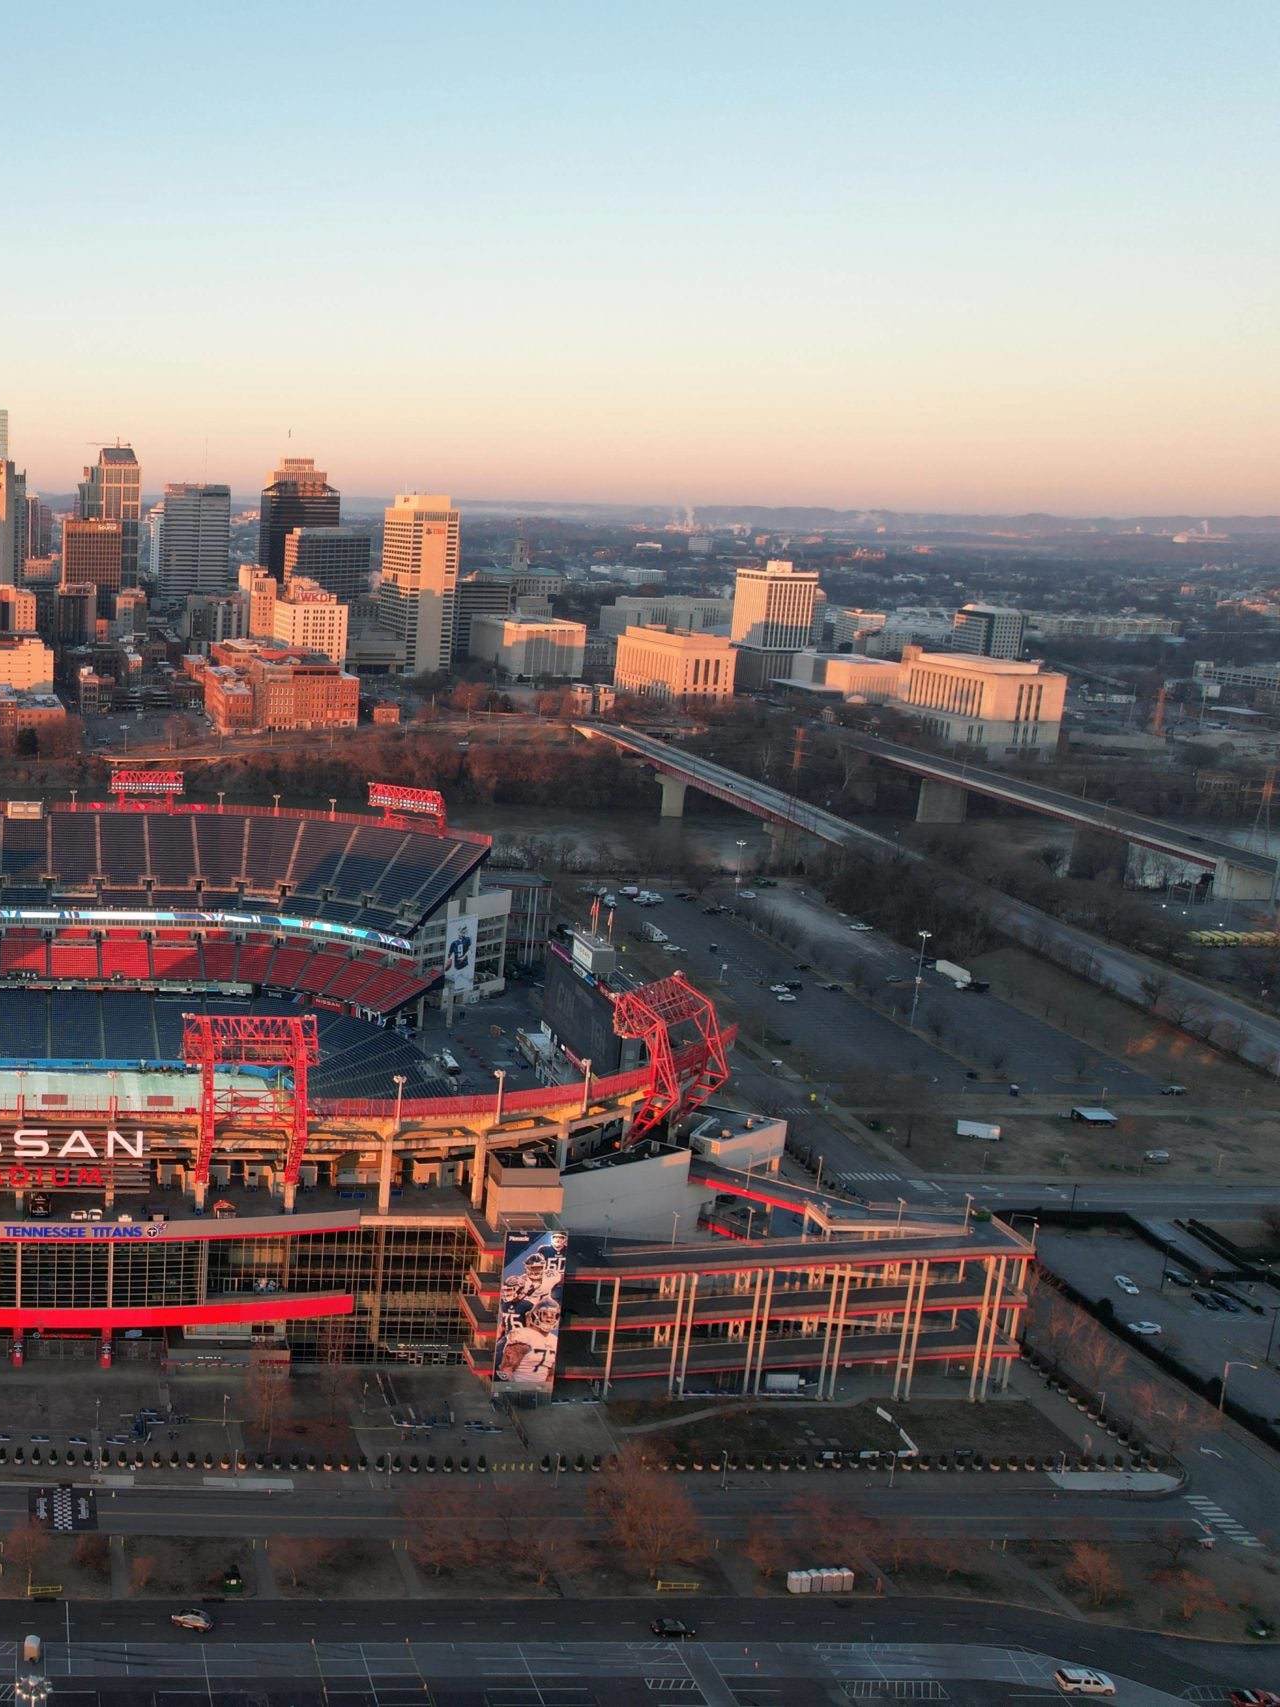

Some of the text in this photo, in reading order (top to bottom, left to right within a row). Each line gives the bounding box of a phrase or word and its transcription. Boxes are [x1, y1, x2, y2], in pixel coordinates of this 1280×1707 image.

[301, 592, 337, 603] WKDF
[457, 943, 464, 958] 9
[315, 998, 341, 1008] NISSAN
[4, 1226, 86, 1238] TENNESSEE
[91, 1226, 142, 1238] TITANS
